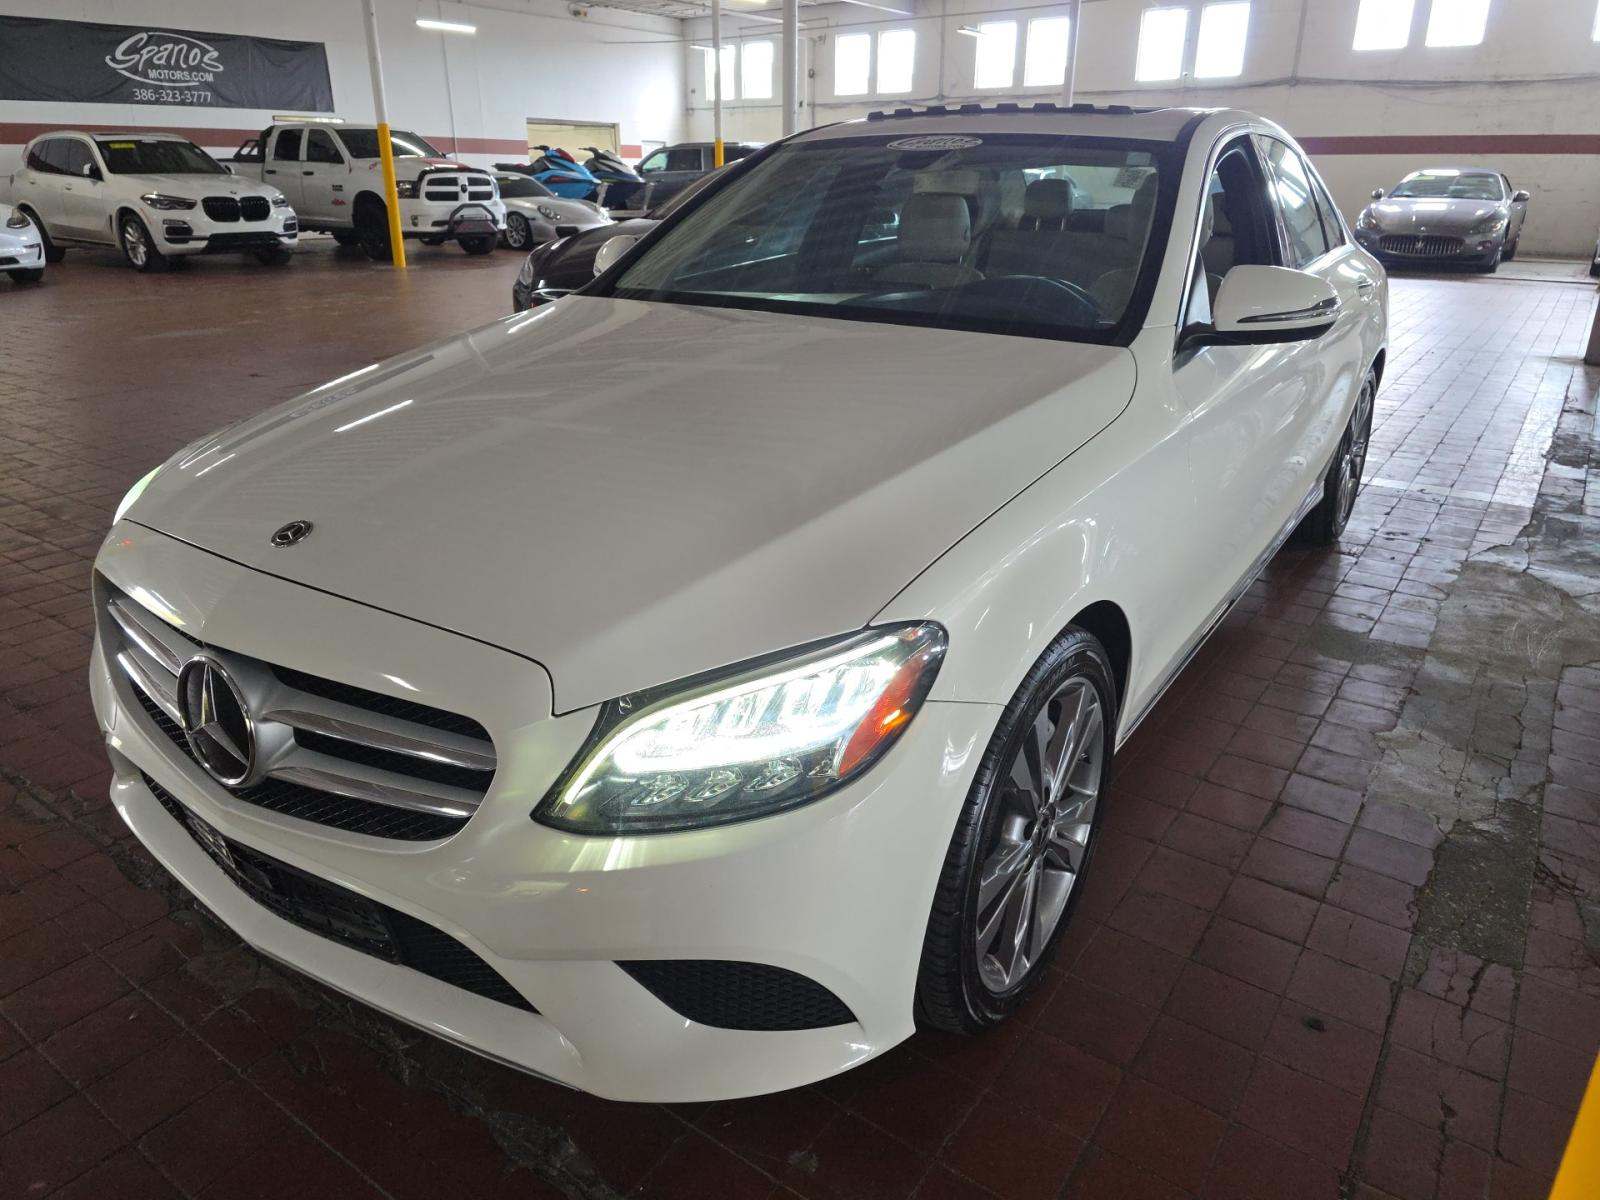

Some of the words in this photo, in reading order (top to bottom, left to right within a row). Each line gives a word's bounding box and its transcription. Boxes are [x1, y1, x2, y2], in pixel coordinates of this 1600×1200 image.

[105, 32, 224, 72] Spanos
[147, 69, 214, 82] MOTORS.COM
[132, 88, 211, 103] 386-323-3777
